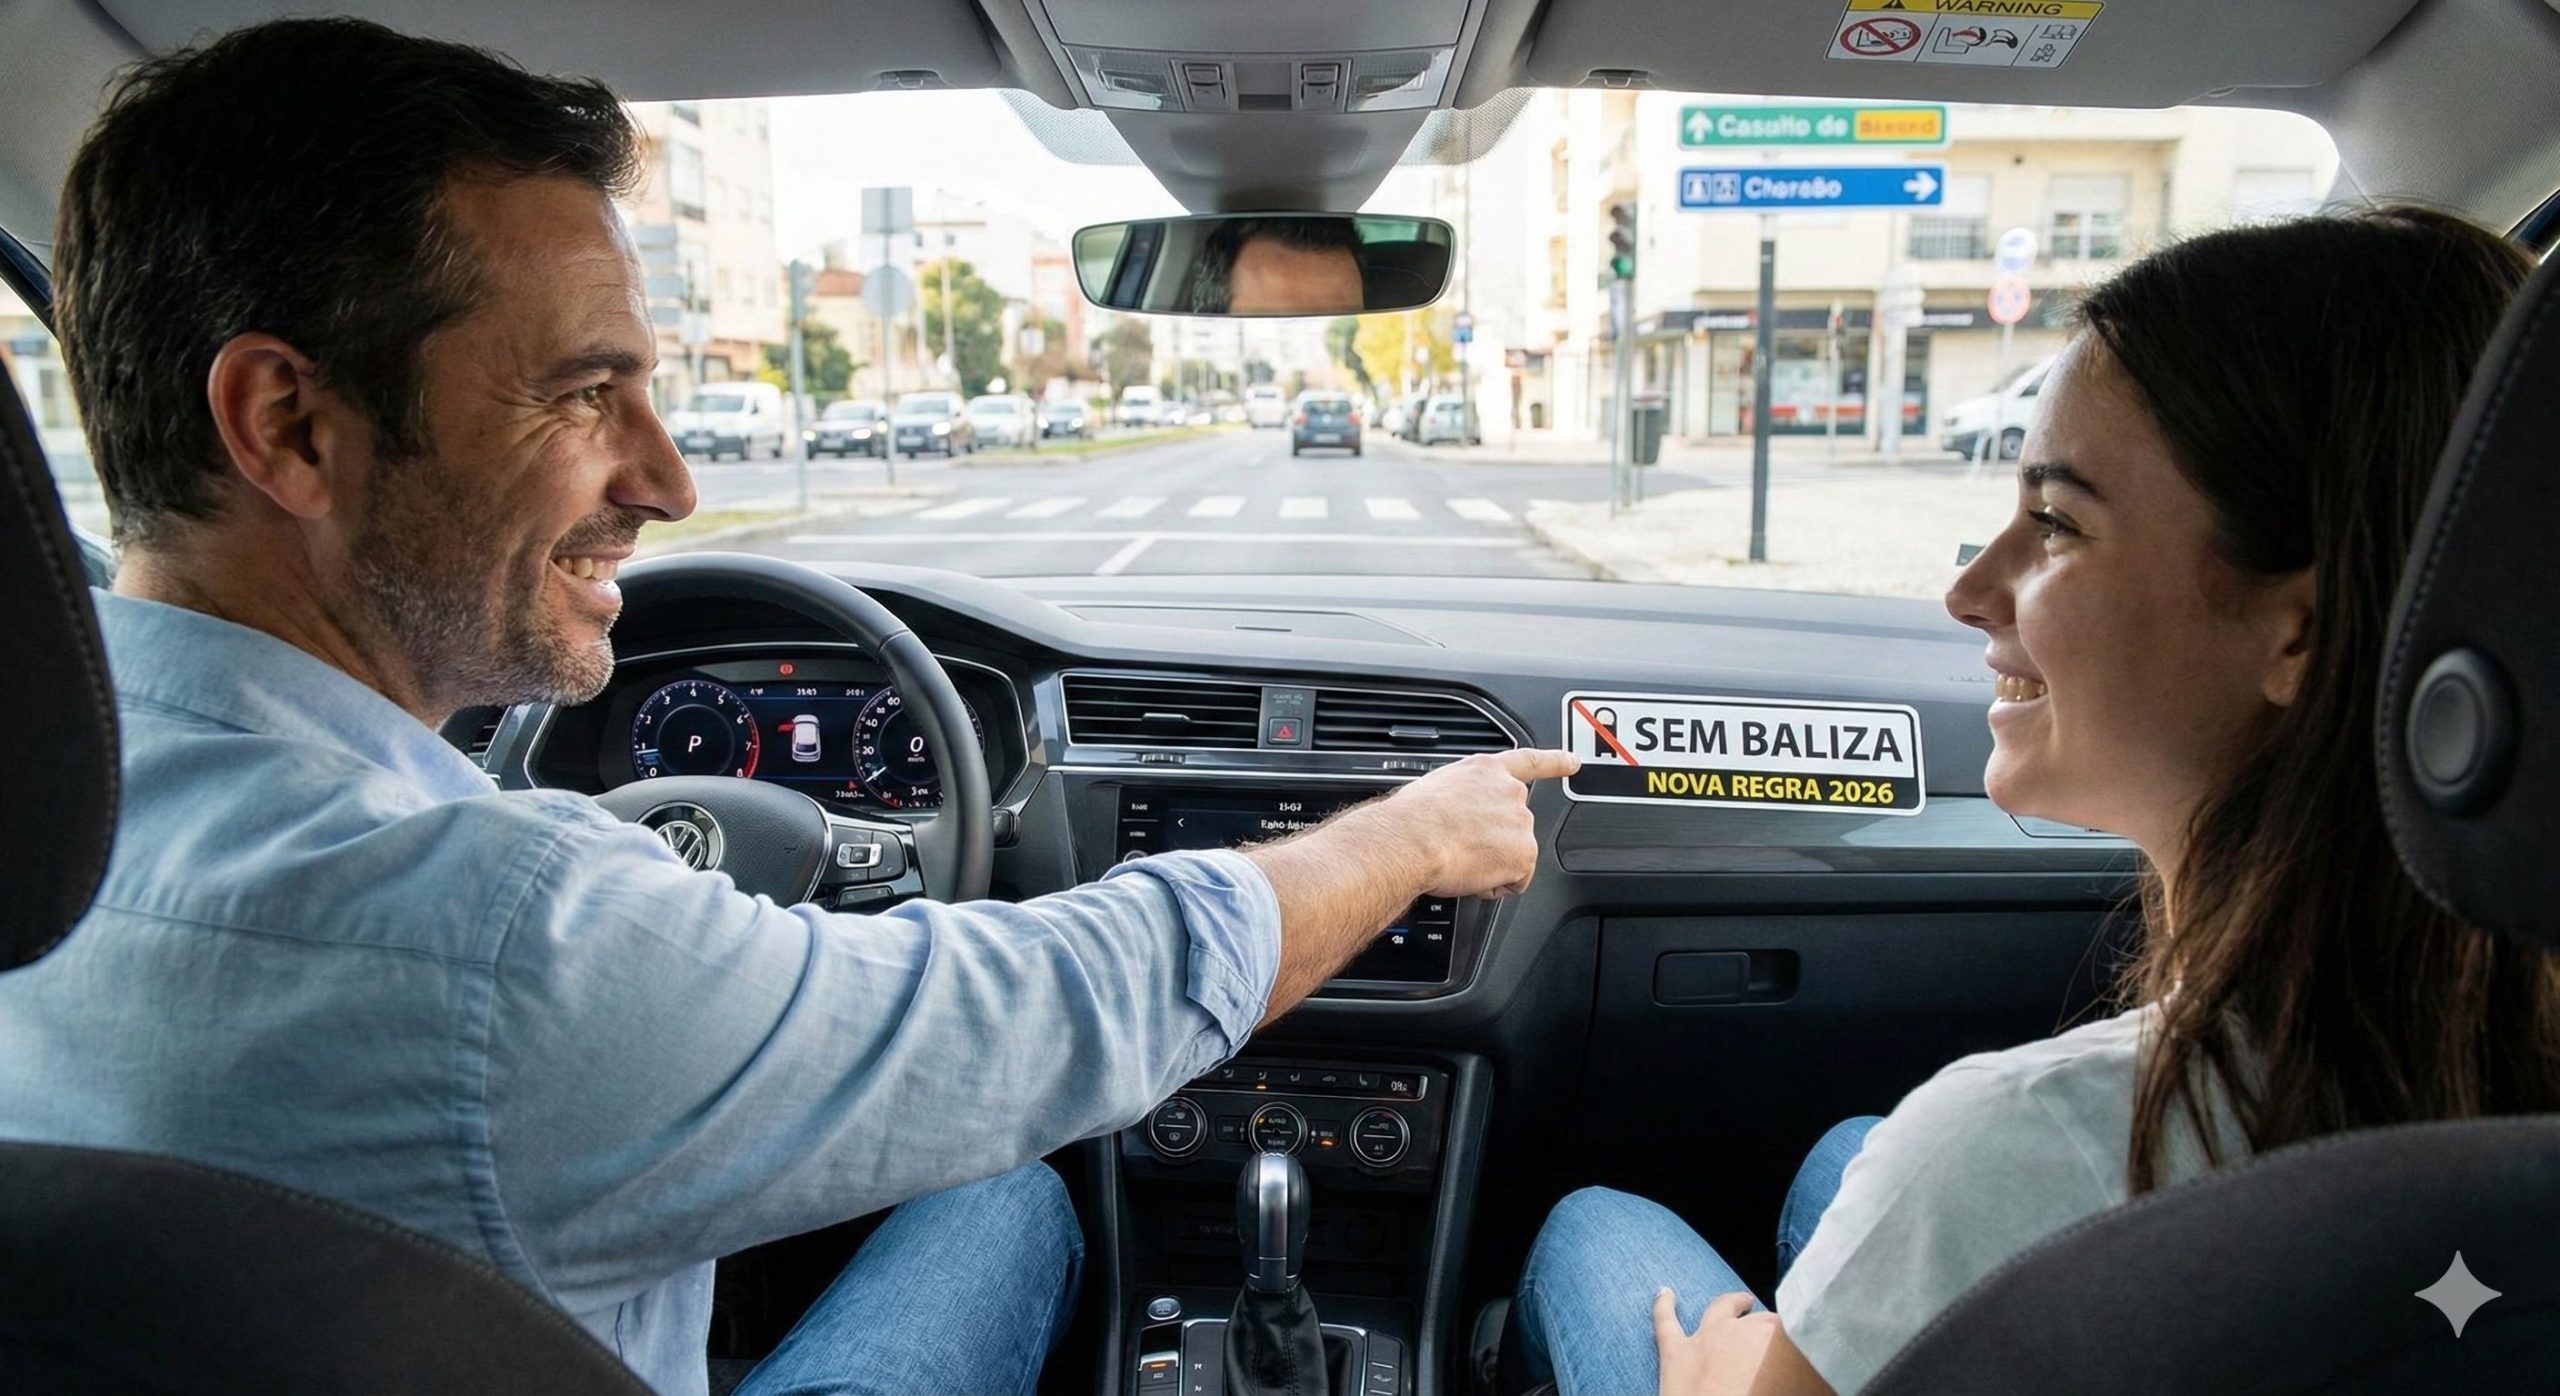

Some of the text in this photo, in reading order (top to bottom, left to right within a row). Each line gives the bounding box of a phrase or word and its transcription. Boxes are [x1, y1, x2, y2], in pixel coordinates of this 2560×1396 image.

[1935, 0, 2063, 15] WARNING
[1816, 113, 1849, 138] de
[865, 718, 878, 728] 40
[687, 735, 702, 752] P
[909, 736, 924, 753] 0
[1635, 716, 1903, 763] SEM BALIZA
[1647, 771, 1894, 804] NOVA REGRA 2026
